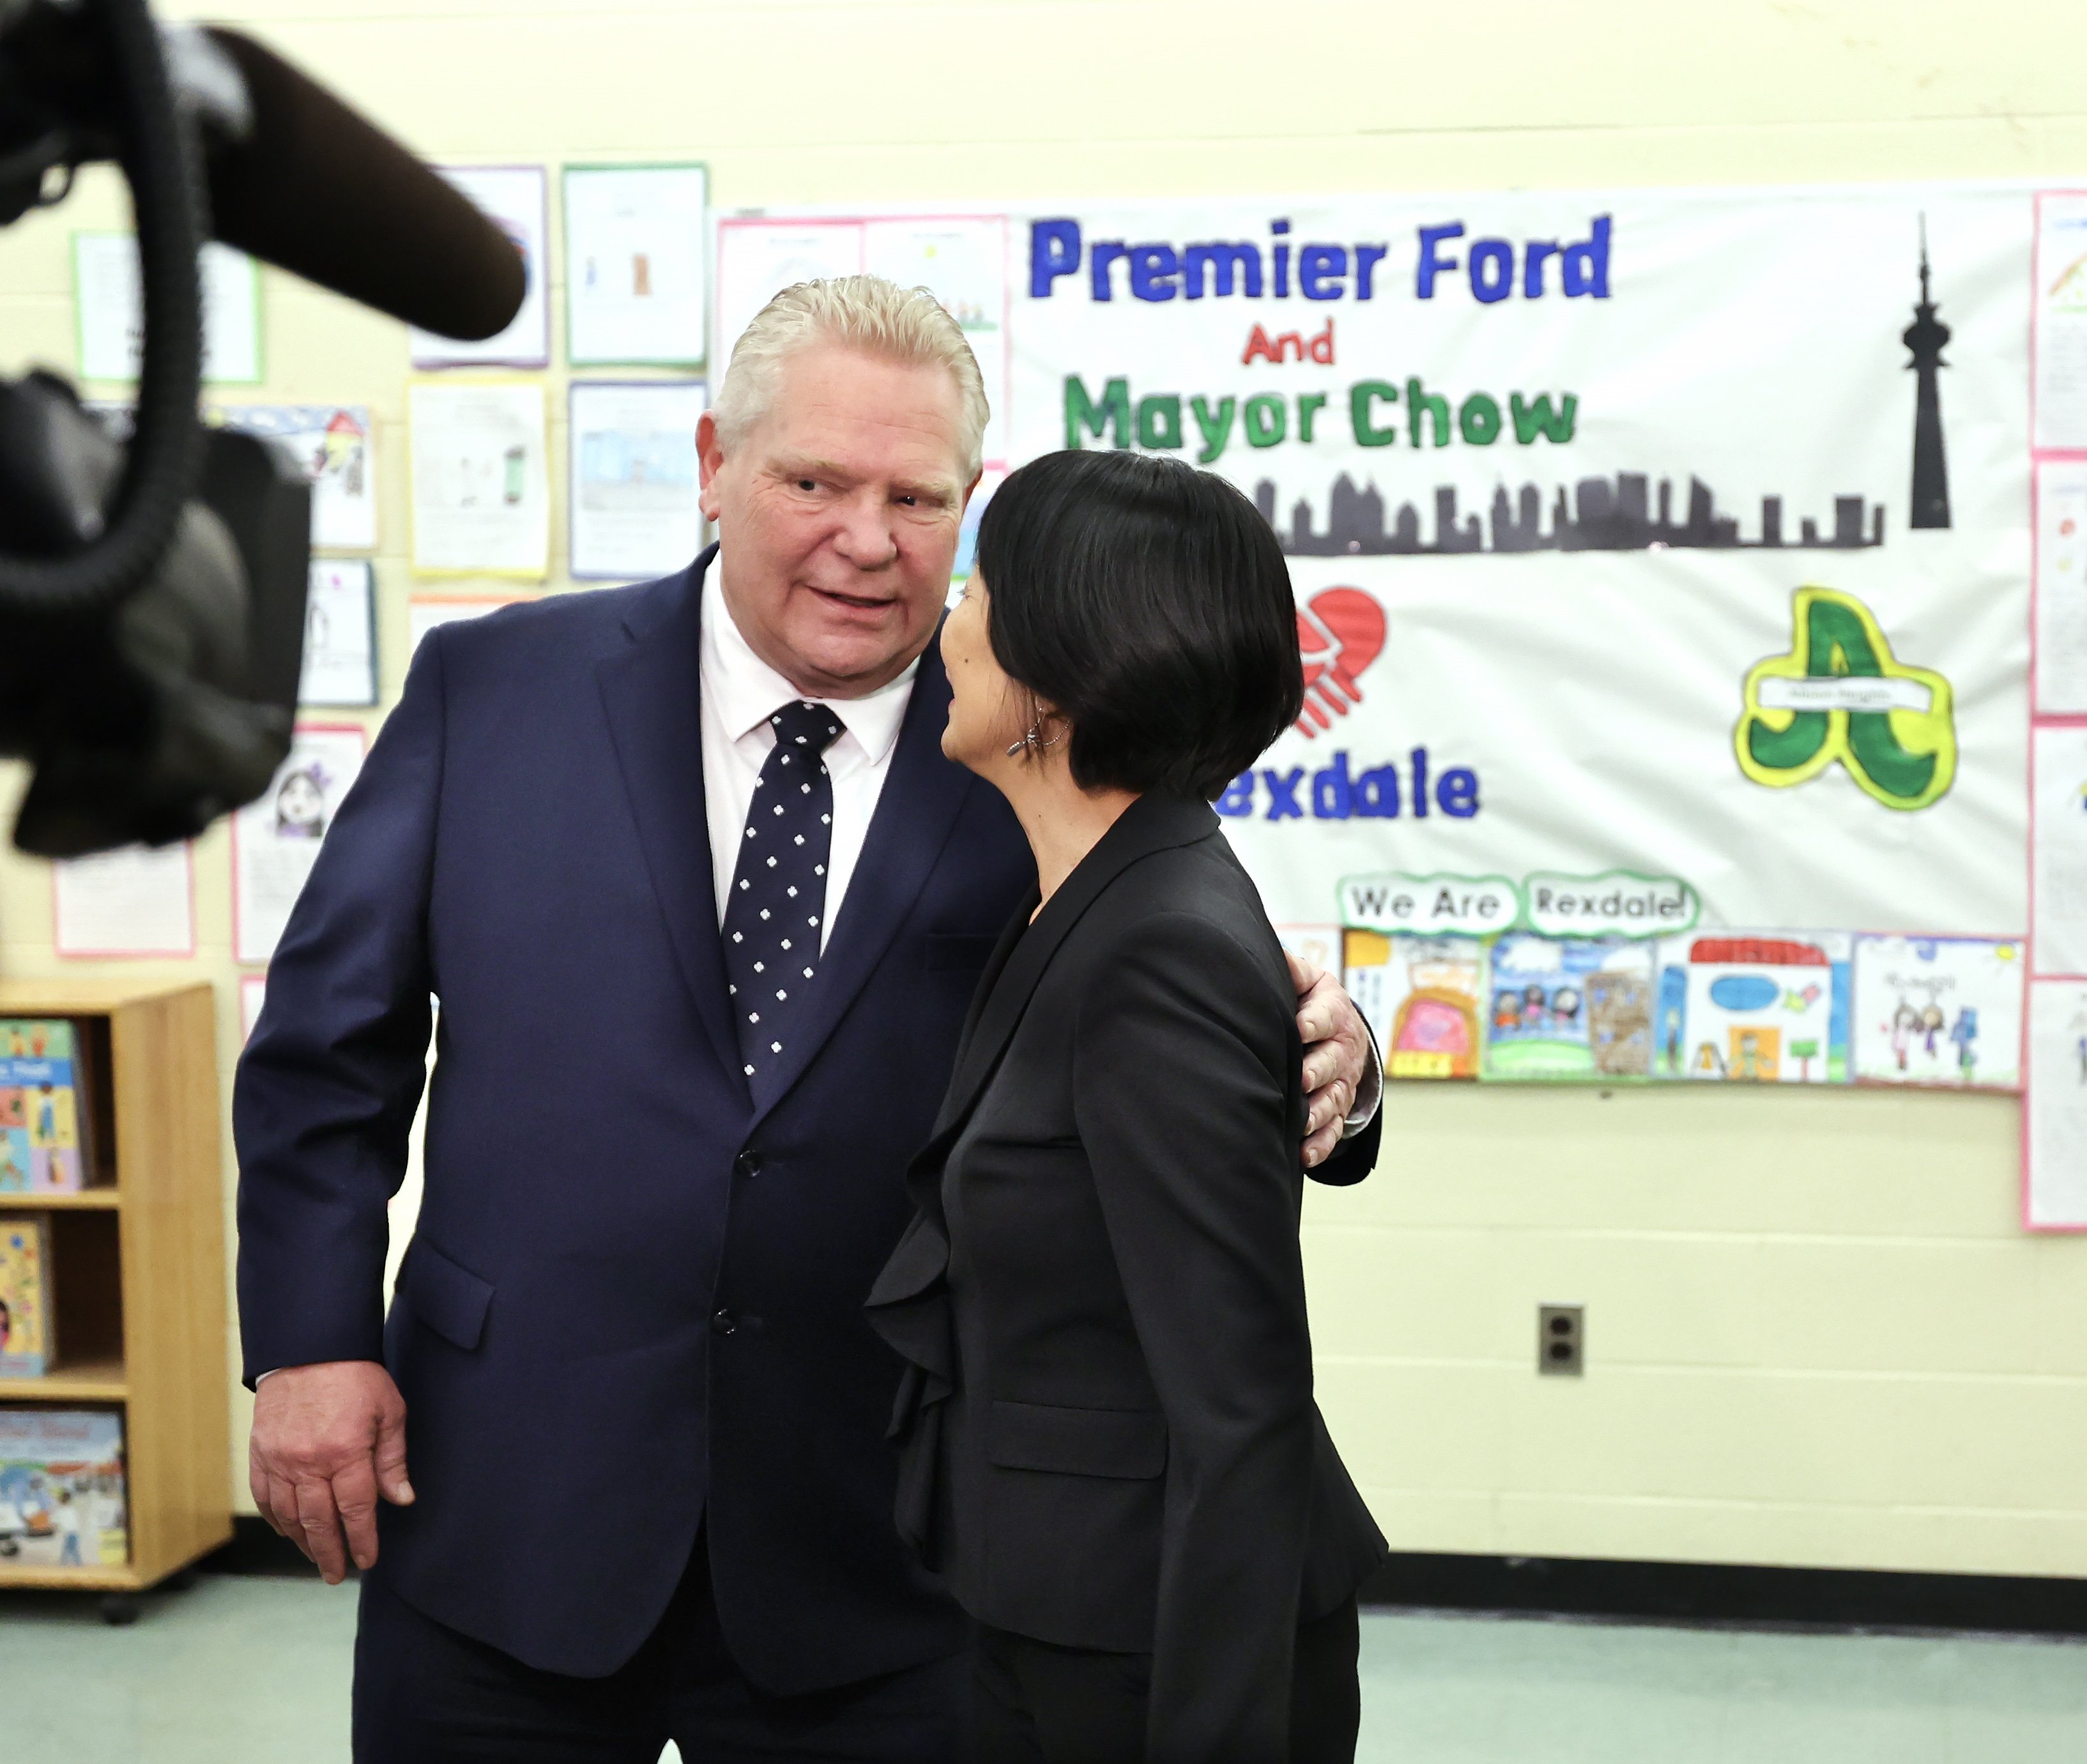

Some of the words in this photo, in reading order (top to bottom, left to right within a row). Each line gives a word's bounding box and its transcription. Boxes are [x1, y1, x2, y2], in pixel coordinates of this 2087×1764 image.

[1030, 218, 1387, 302] Premier
[1417, 216, 1610, 302] Ford
[1243, 318, 1334, 365] And
[1064, 376, 1327, 463] Mayor
[1350, 377, 1578, 448] Chow
[1215, 749, 1480, 821] exdale
[1352, 886, 1416, 918] We
[1432, 886, 1500, 918] Are
